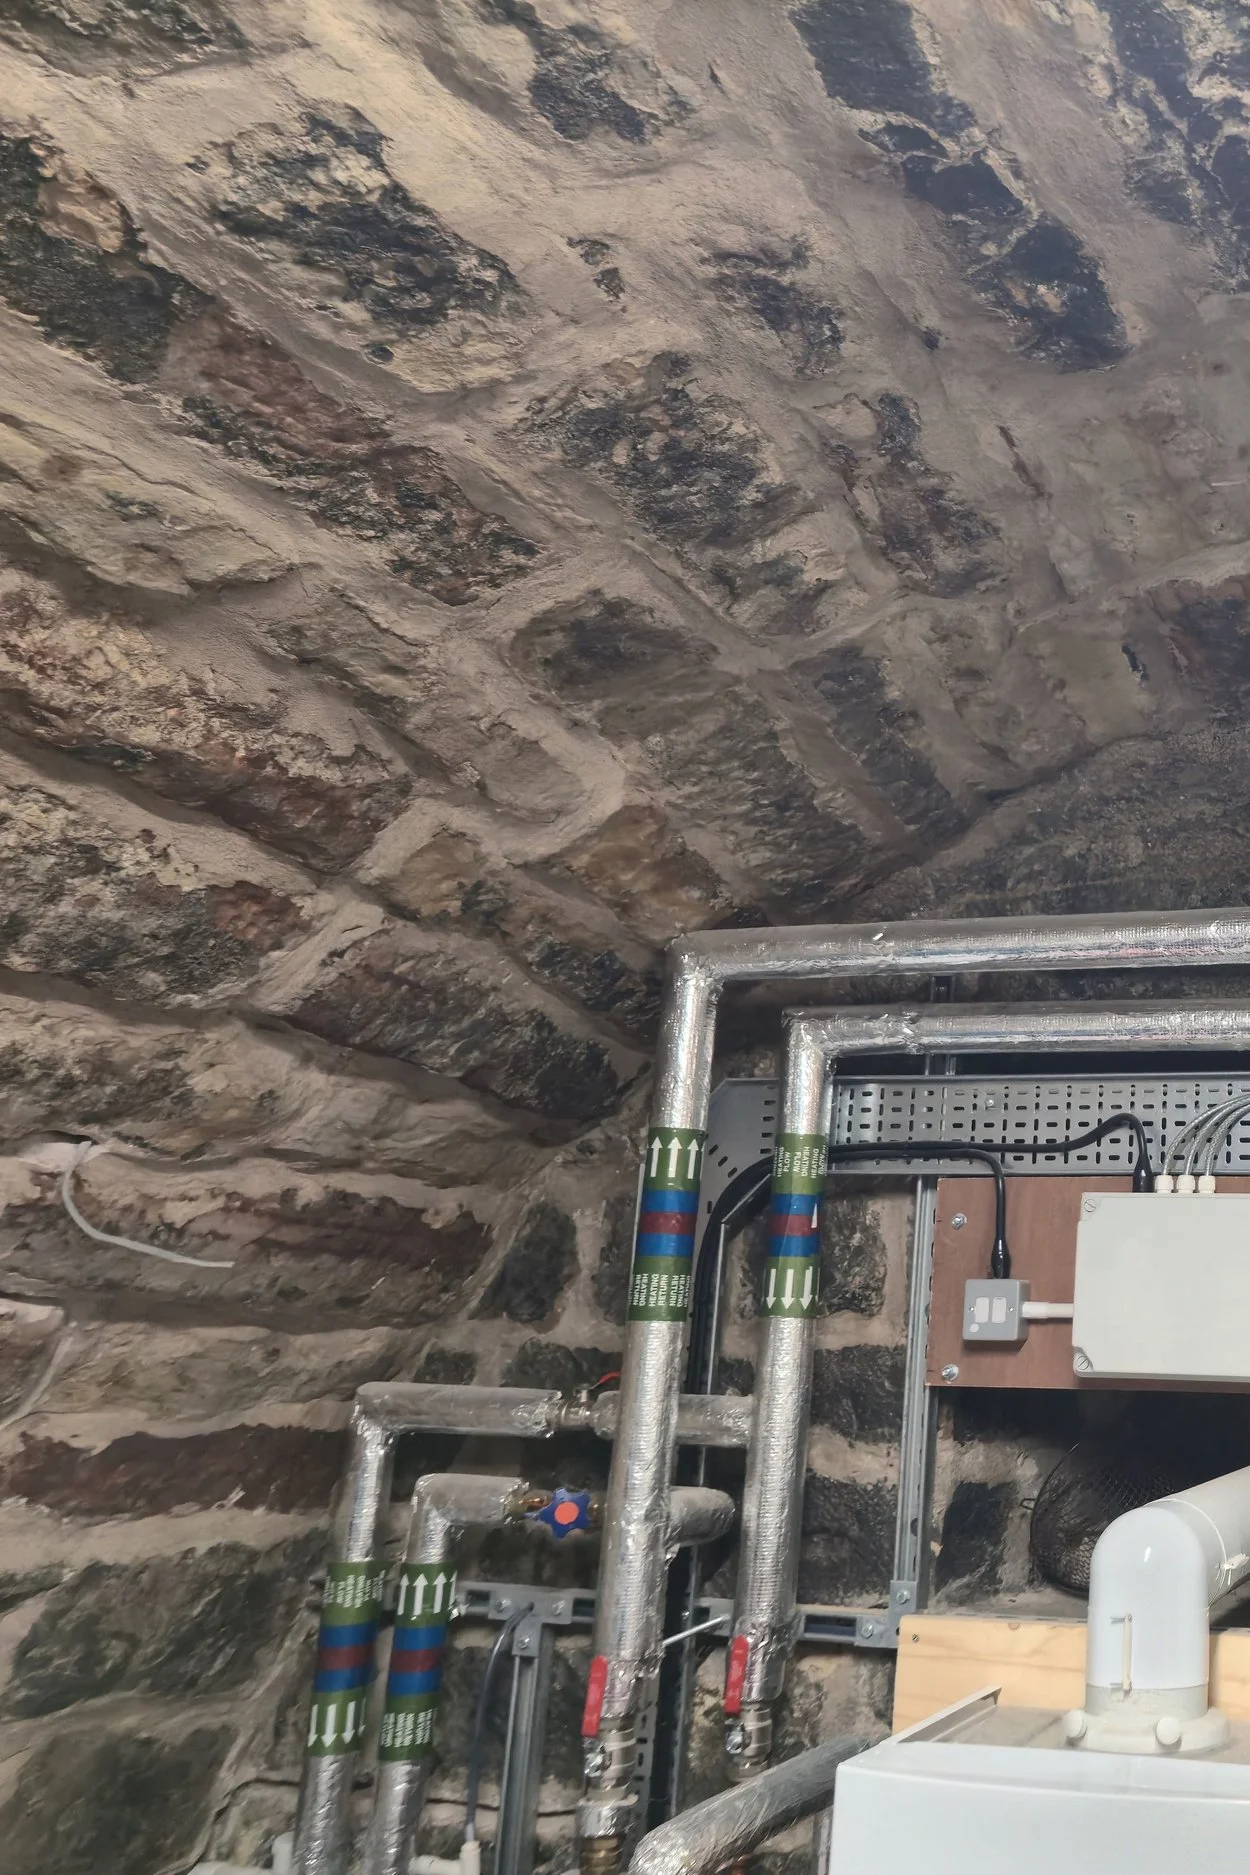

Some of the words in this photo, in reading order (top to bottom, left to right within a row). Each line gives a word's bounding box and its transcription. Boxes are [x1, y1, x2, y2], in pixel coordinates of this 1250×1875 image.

[792, 1151, 802, 1173] FLOW
[801, 1146, 811, 1177] HEATING
[648, 1273, 660, 1307] HEATING
